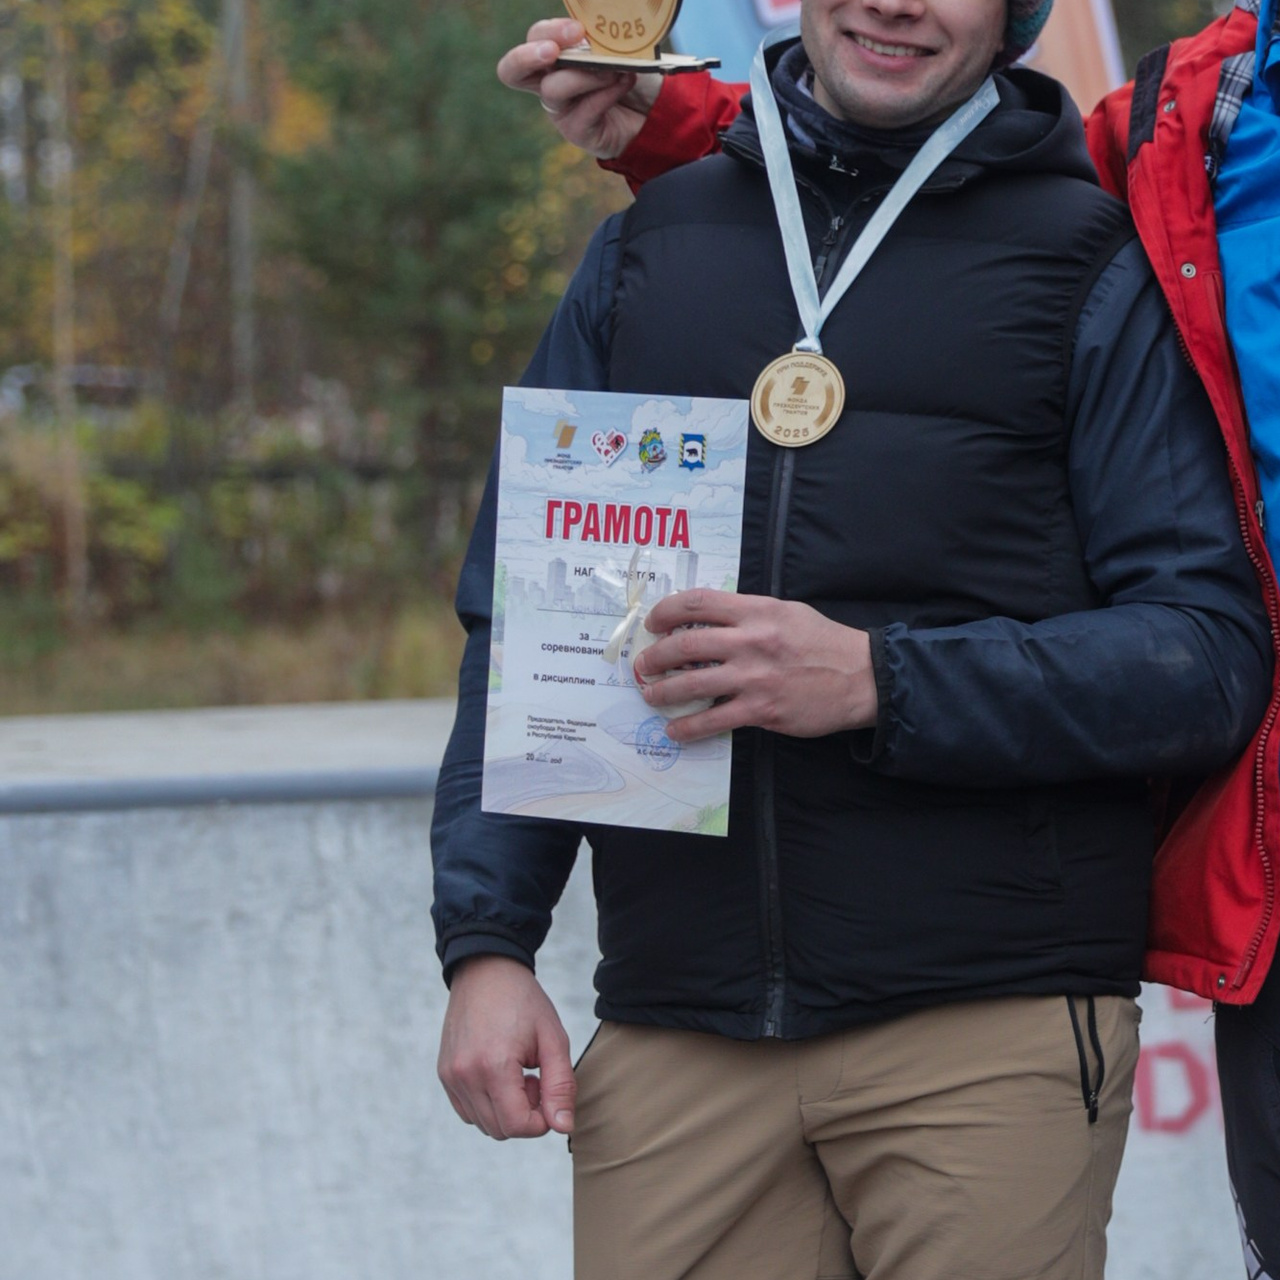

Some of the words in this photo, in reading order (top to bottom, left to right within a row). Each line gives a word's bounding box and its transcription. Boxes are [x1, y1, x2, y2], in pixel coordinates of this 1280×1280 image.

[595, 14, 646, 40] 2025
[773, 425, 810, 439] 2025
[545, 499, 691, 550] ГРАМОТА
[579, 632, 590, 641] за
[533, 673, 539, 681] в
[541, 673, 596, 686] дисциплине
